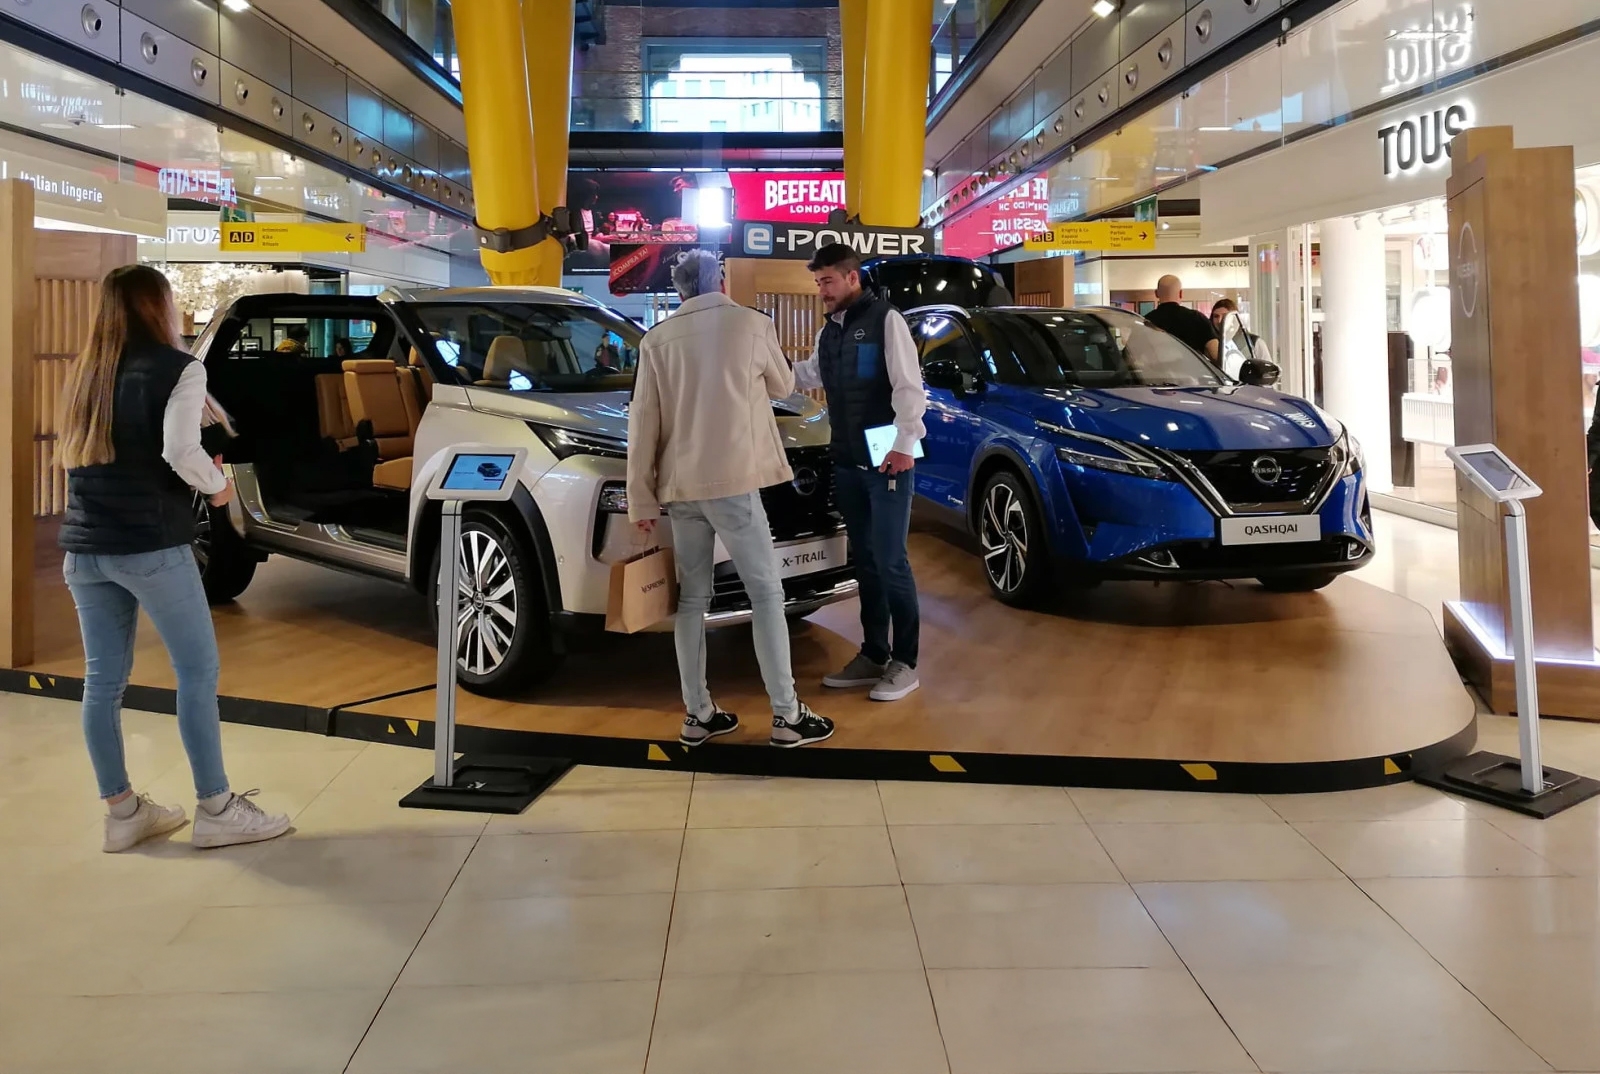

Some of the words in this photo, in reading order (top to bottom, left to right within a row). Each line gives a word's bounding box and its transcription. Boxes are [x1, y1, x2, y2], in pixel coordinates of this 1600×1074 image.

[1377, 105, 1468, 175] TOUS
[61, 180, 103, 203] lingerie
[790, 204, 838, 214] LONDON
[746, 226, 925, 256] e-POWER
[1195, 260, 1217, 268] ZONA
[1244, 523, 1298, 536] QASHQAI
[781, 550, 827, 568] X-TRAIL
